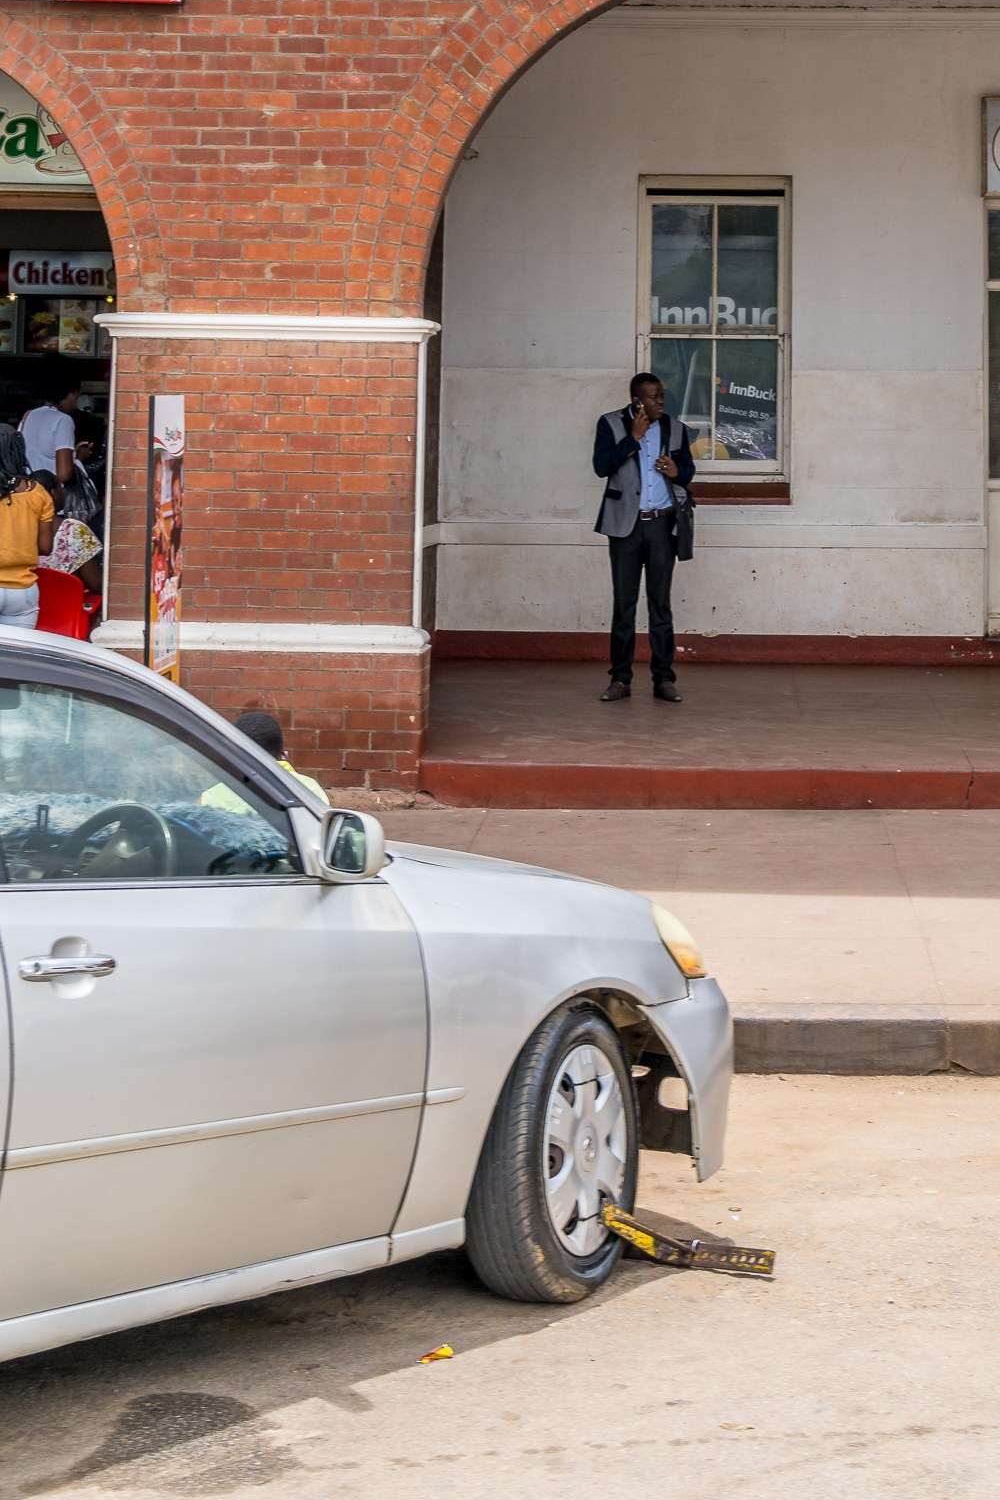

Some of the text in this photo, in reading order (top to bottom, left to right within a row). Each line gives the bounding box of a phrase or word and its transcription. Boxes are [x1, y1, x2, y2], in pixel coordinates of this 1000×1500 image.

[13, 260, 105, 286] Chicken
[718, 404, 770, 421] Balance $0.50
